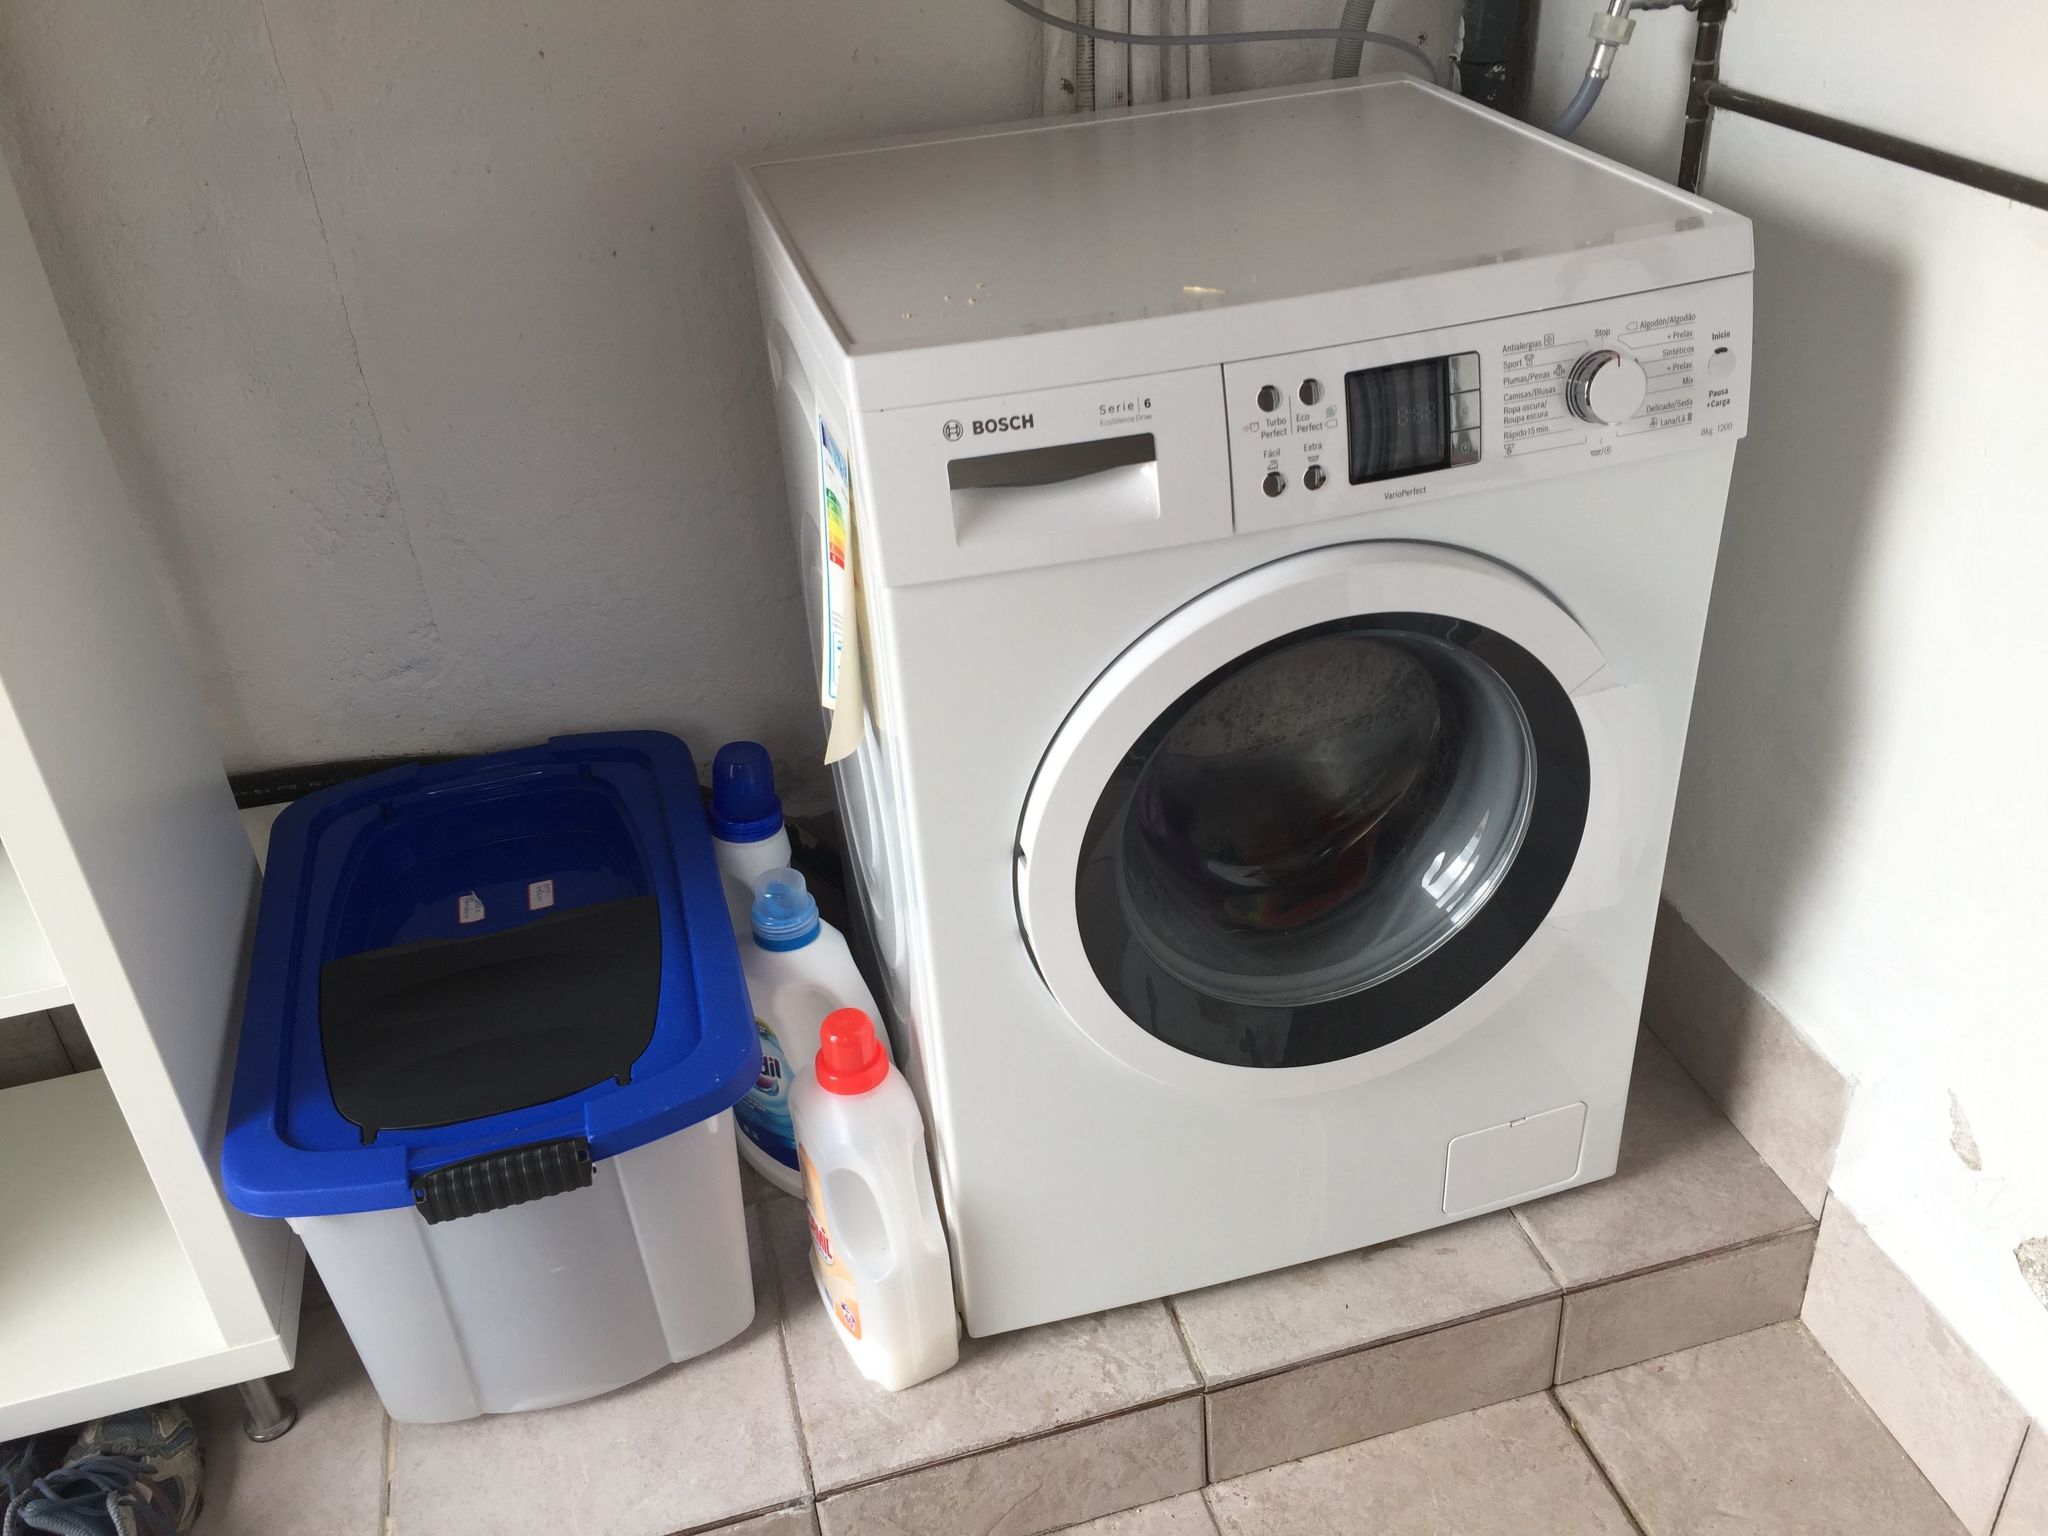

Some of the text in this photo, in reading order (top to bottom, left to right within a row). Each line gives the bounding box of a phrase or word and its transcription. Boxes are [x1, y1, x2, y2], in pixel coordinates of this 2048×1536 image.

[1640, 313, 1696, 330] Algodón/Algodão
[1594, 328, 1611, 338] Stop
[1711, 330, 1731, 340] Inicio
[1502, 340, 1542, 353] Antialergias
[1662, 346, 1695, 357] Sintéticos
[1503, 359, 1522, 371] Sport
[1503, 372, 1550, 385] Plumas/Penas
[1682, 376, 1694, 385] Mix
[1503, 386, 1556, 401] Camisas/Blusas
[1708, 388, 1729, 398] Pausa
[1099, 398, 1151, 415] Serie 6
[1503, 406, 1521, 415] Ropa
[1646, 398, 1693, 413] Delicado/Seda
[1266, 417, 1287, 427] Turbo
[1296, 413, 1310, 422] Eco
[1503, 410, 1549, 425] Roupa escura
[972, 413, 1034, 435] BOSCH
[1297, 422, 1323, 433] Perfect
[1717, 422, 1733, 432] 1200
[1261, 428, 1287, 439] Perfect
[1503, 429, 1527, 440] Rápido
[1528, 426, 1535, 435] 15
[1303, 442, 1323, 453] Extra
[1263, 448, 1281, 459] Fácil
[1384, 486, 1426, 500] VarioPerfect
